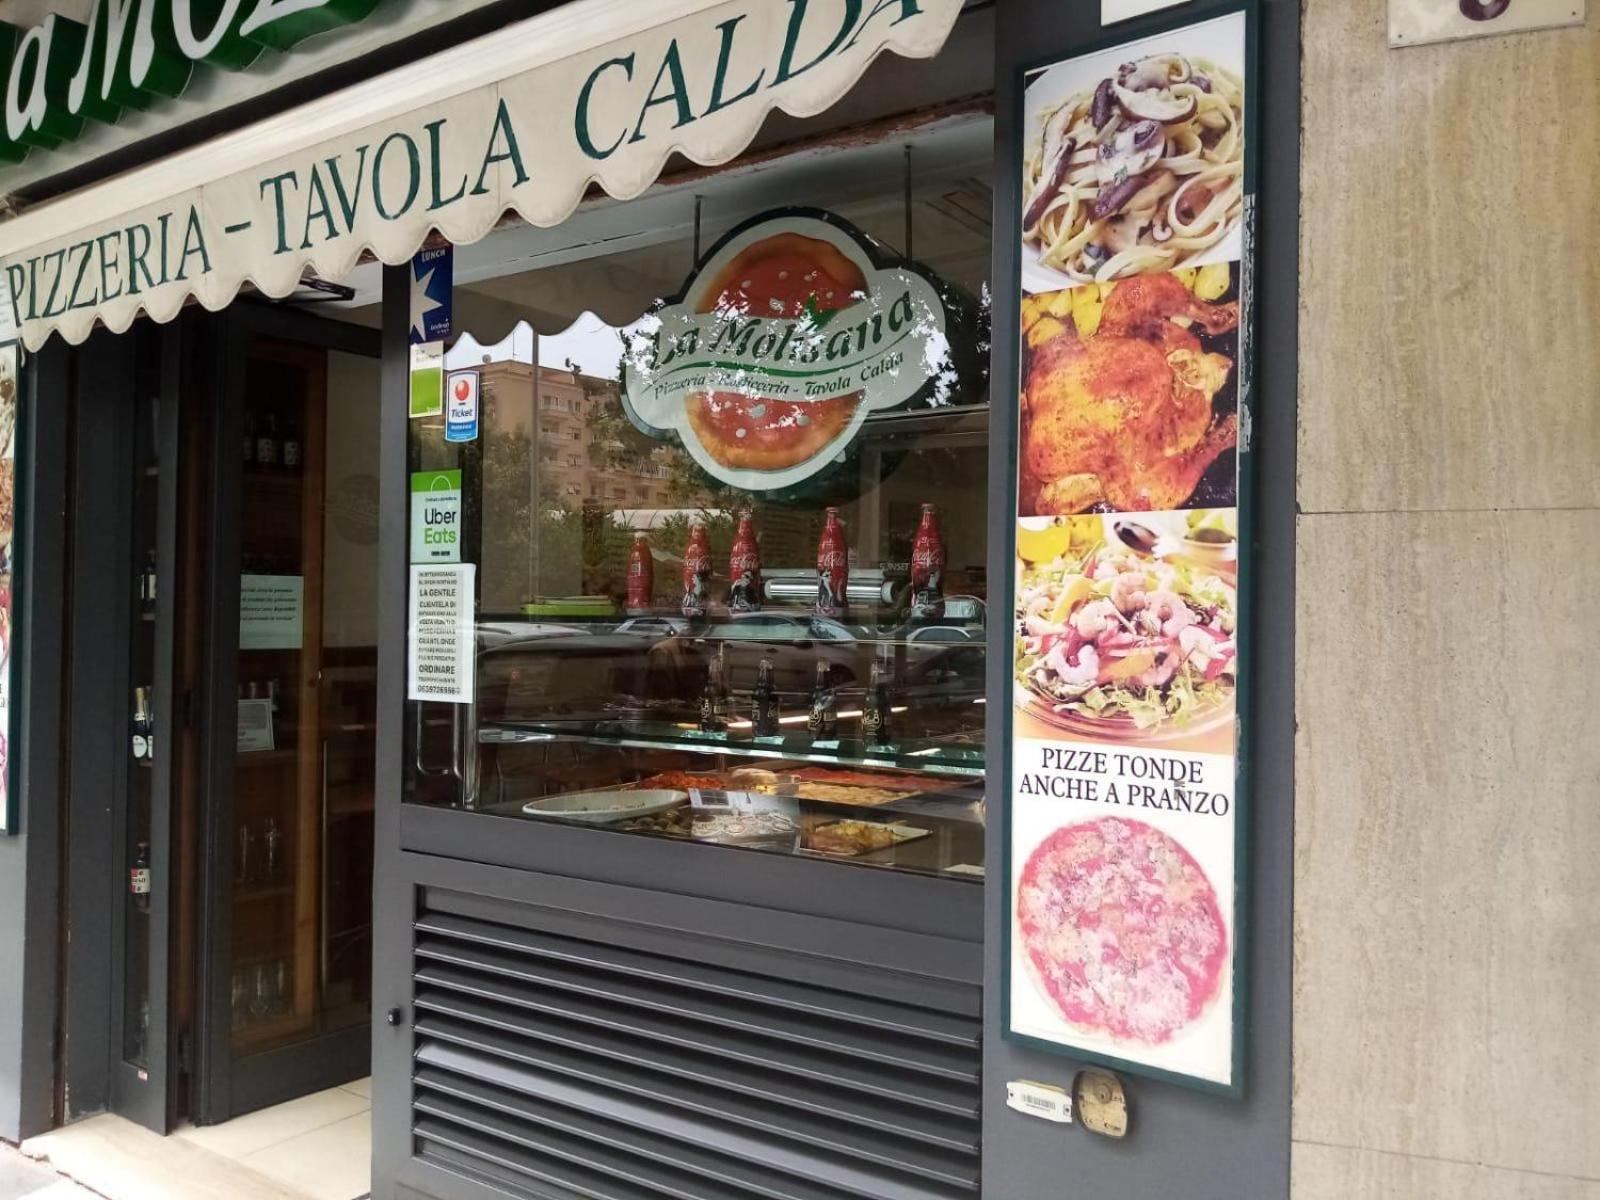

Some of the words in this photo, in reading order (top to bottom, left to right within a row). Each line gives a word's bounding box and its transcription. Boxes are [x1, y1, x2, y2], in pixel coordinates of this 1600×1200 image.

[6, 203, 213, 328] PIZZERIA
[259, 96, 530, 255] TAVOLA
[574, 0, 924, 161] CALDA
[421, 248, 446, 263] LUNCH
[805, 376, 851, 396] Tavola
[451, 408, 474, 419] Ticket
[424, 507, 457, 525] Uber
[424, 527, 457, 544] Eats
[429, 588, 457, 598] GENTILE
[418, 664, 456, 675] ORDINARE
[1041, 747, 1108, 775] PIZZE
[1113, 753, 1205, 784] TONDE
[1018, 773, 1099, 802] ANCHE
[1103, 781, 1121, 805] A
[1127, 784, 1230, 817] PRANZO
